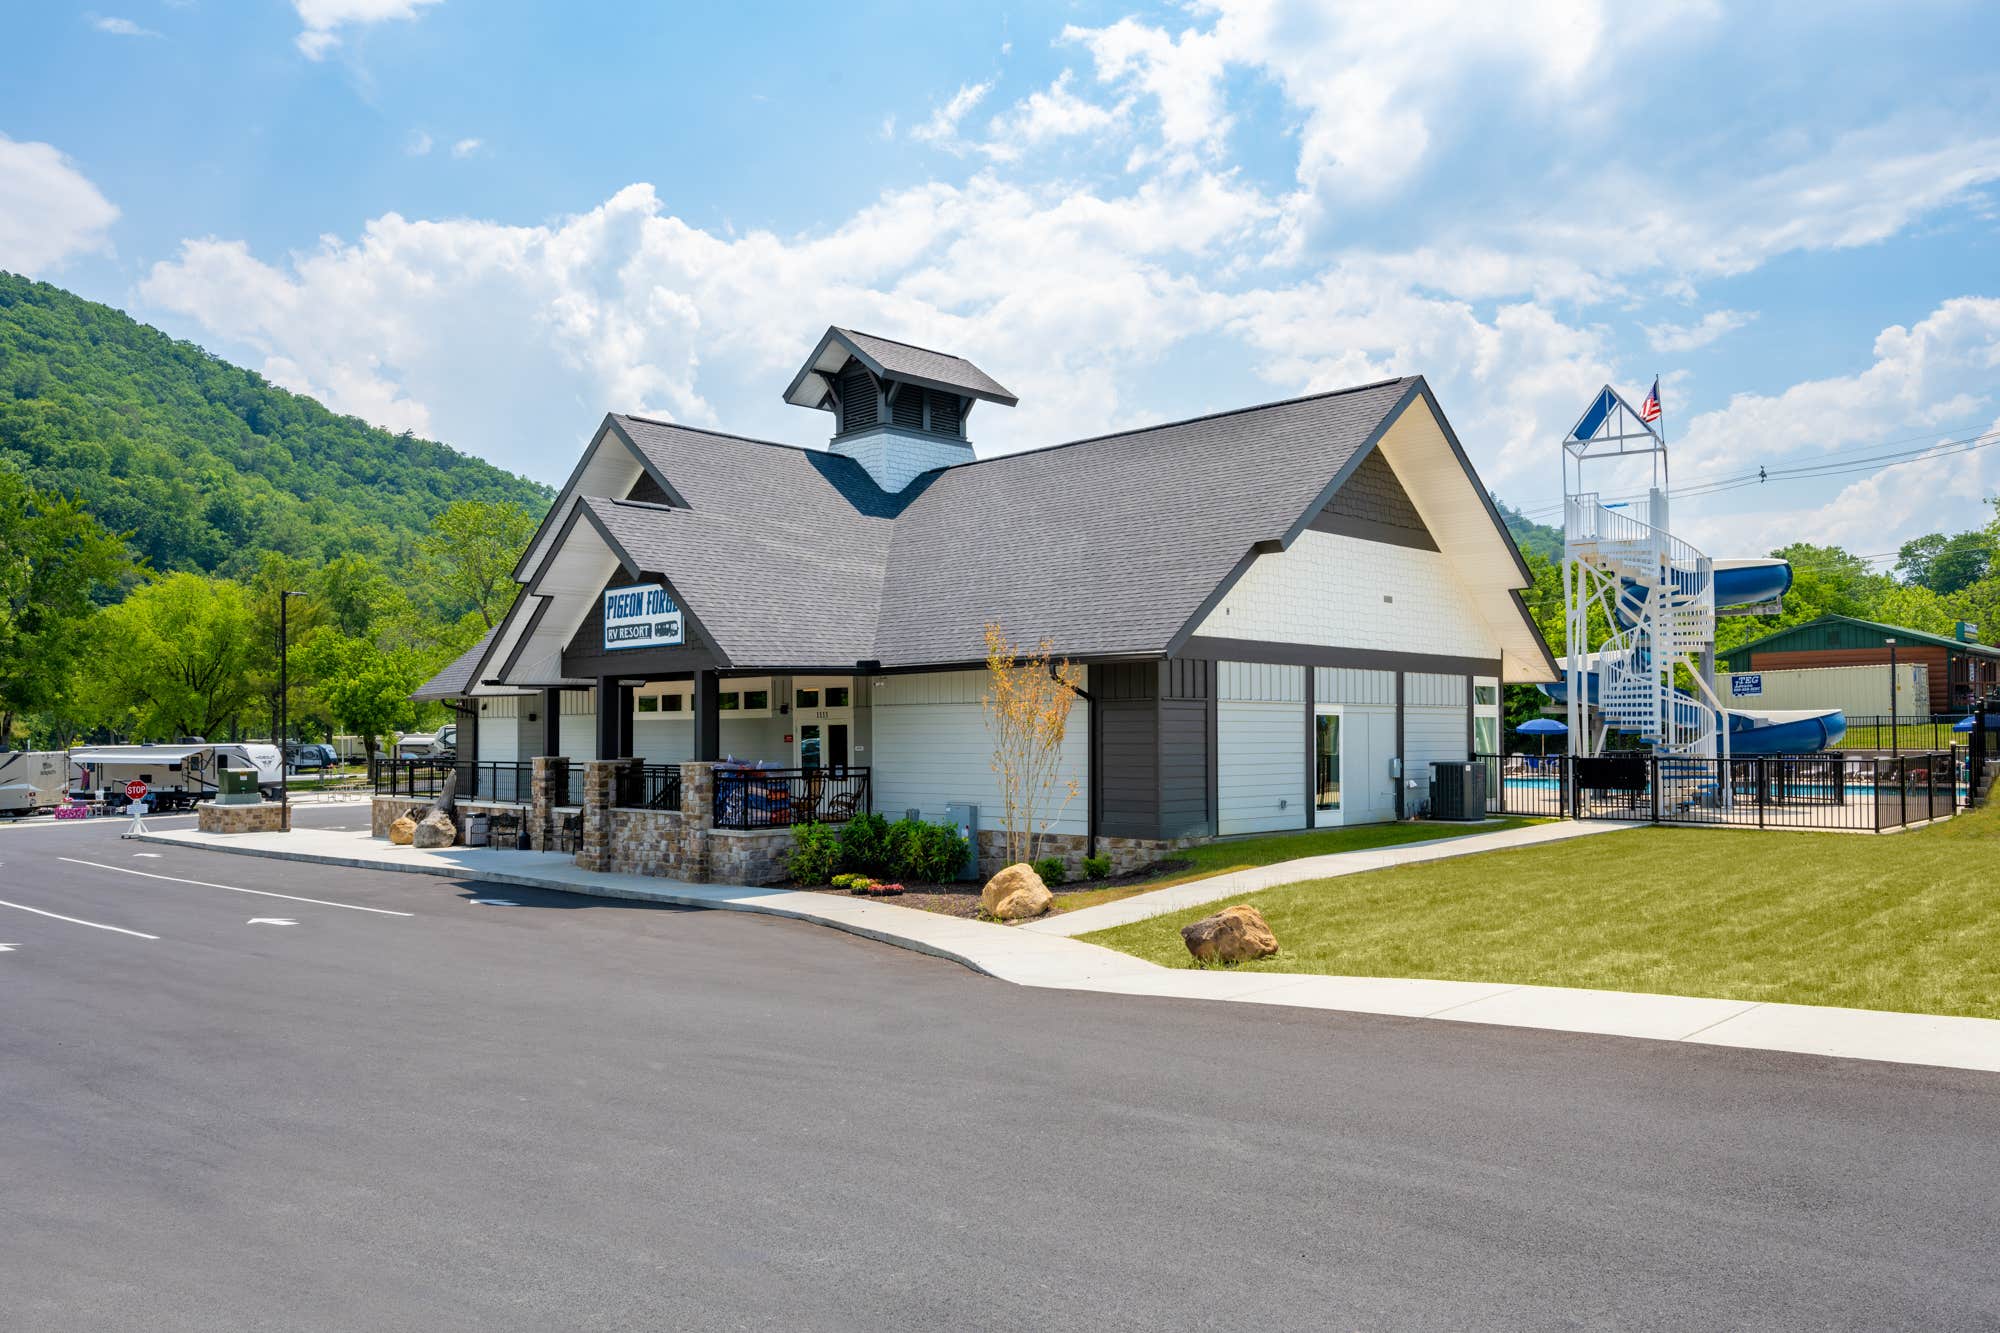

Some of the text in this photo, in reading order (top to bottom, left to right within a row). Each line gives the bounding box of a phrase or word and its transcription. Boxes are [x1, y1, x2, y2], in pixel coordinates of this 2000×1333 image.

[607, 591, 644, 619] PIGEON
[608, 625, 649, 640] RV RESORT
[127, 786, 146, 794] STOP
